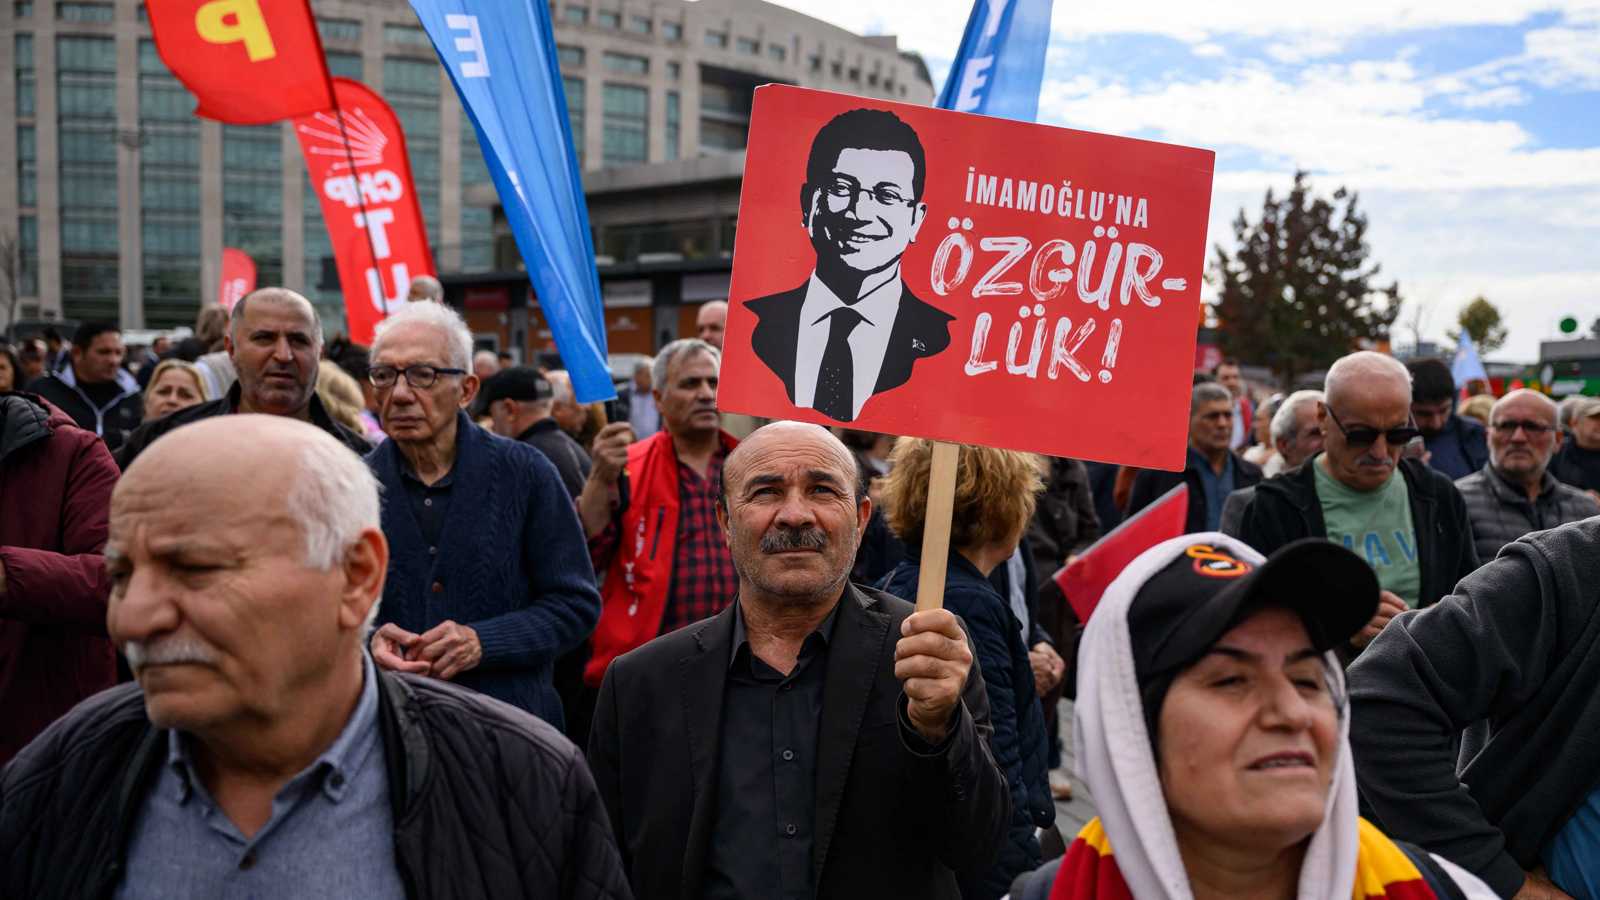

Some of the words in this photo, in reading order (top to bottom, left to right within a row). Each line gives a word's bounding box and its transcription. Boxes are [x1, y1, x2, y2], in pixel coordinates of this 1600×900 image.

[965, 166, 1149, 229] İMAMOĞLU’NA
[930, 216, 1188, 311] ÖZGÜR-
[964, 303, 1123, 384] LÜK!
